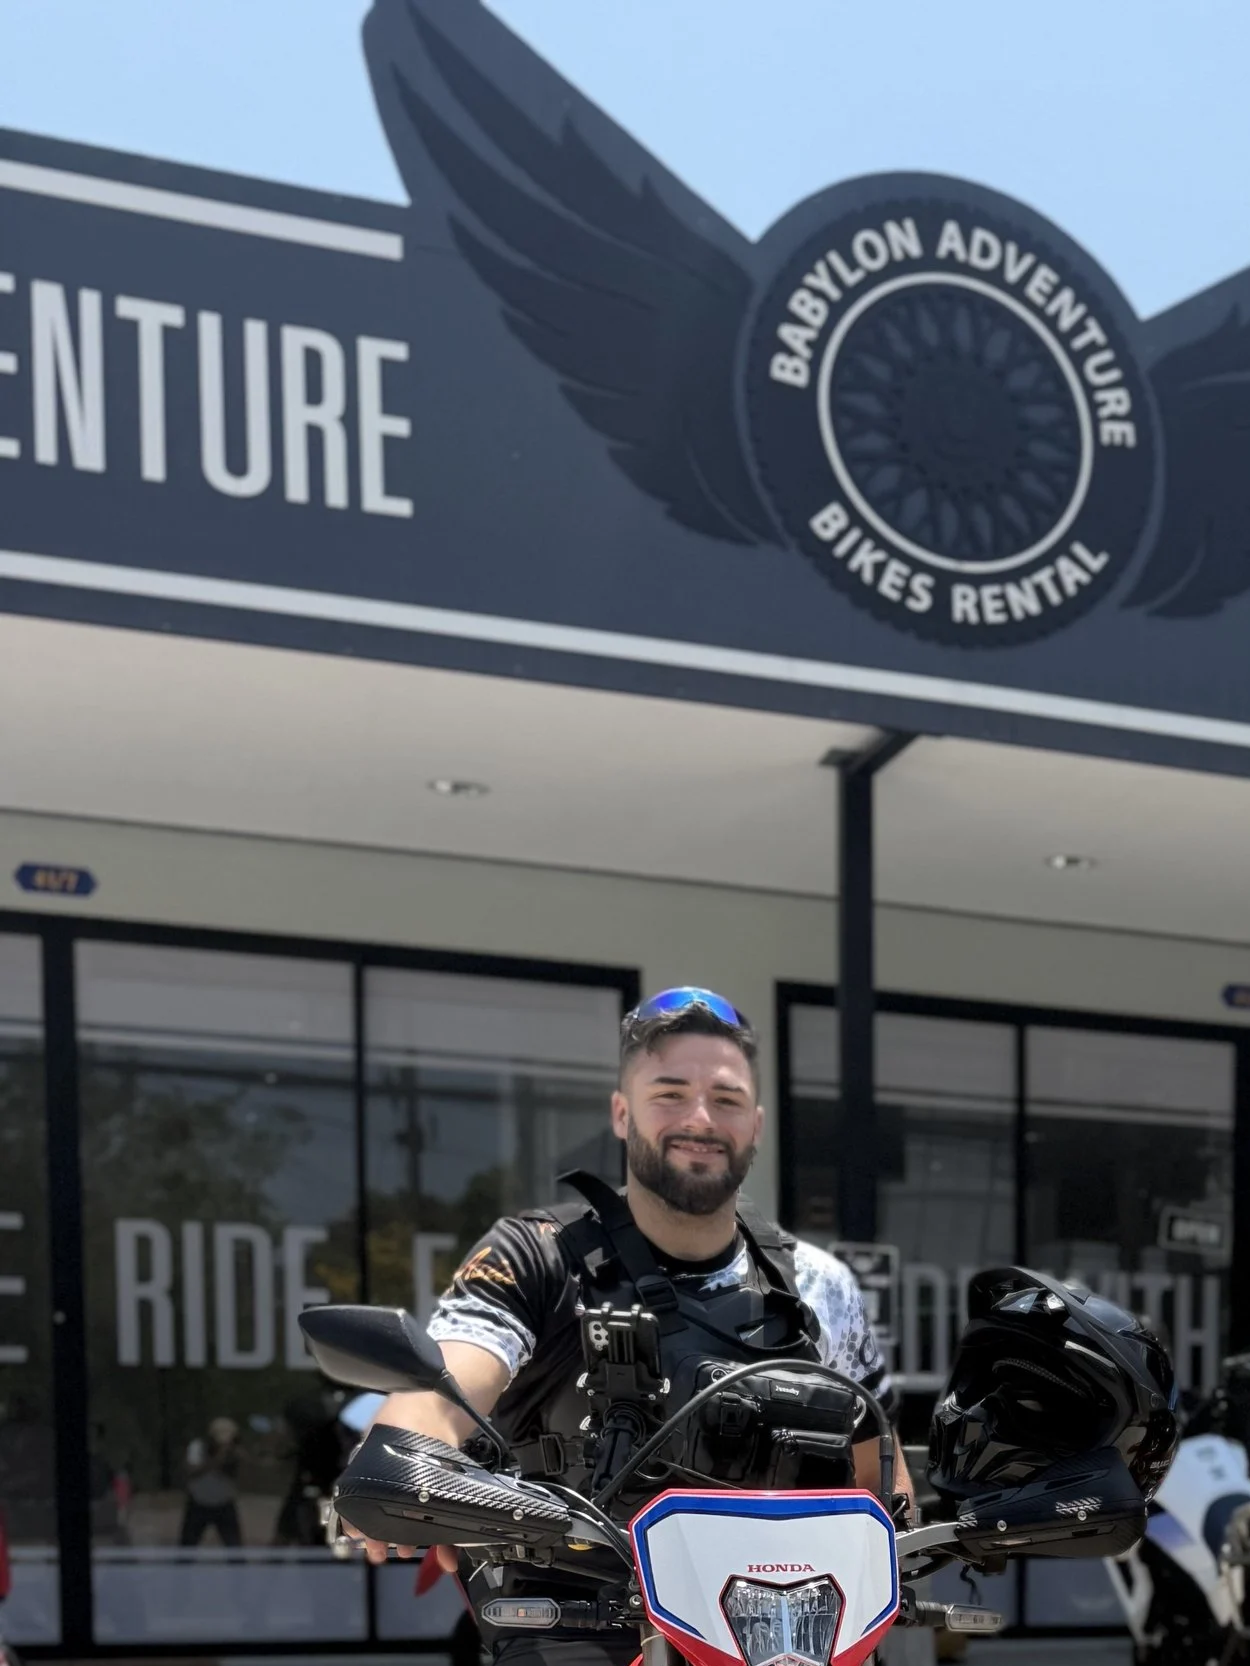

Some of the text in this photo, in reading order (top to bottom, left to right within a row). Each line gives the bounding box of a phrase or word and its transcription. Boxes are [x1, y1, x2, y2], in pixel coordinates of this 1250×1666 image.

[769, 217, 1137, 449] BABYLON ADVENTURE
[809, 501, 1110, 625] BIKES RENTAL
[115, 1218, 332, 1371] RIDE
[746, 1563, 816, 1574] HONDA
